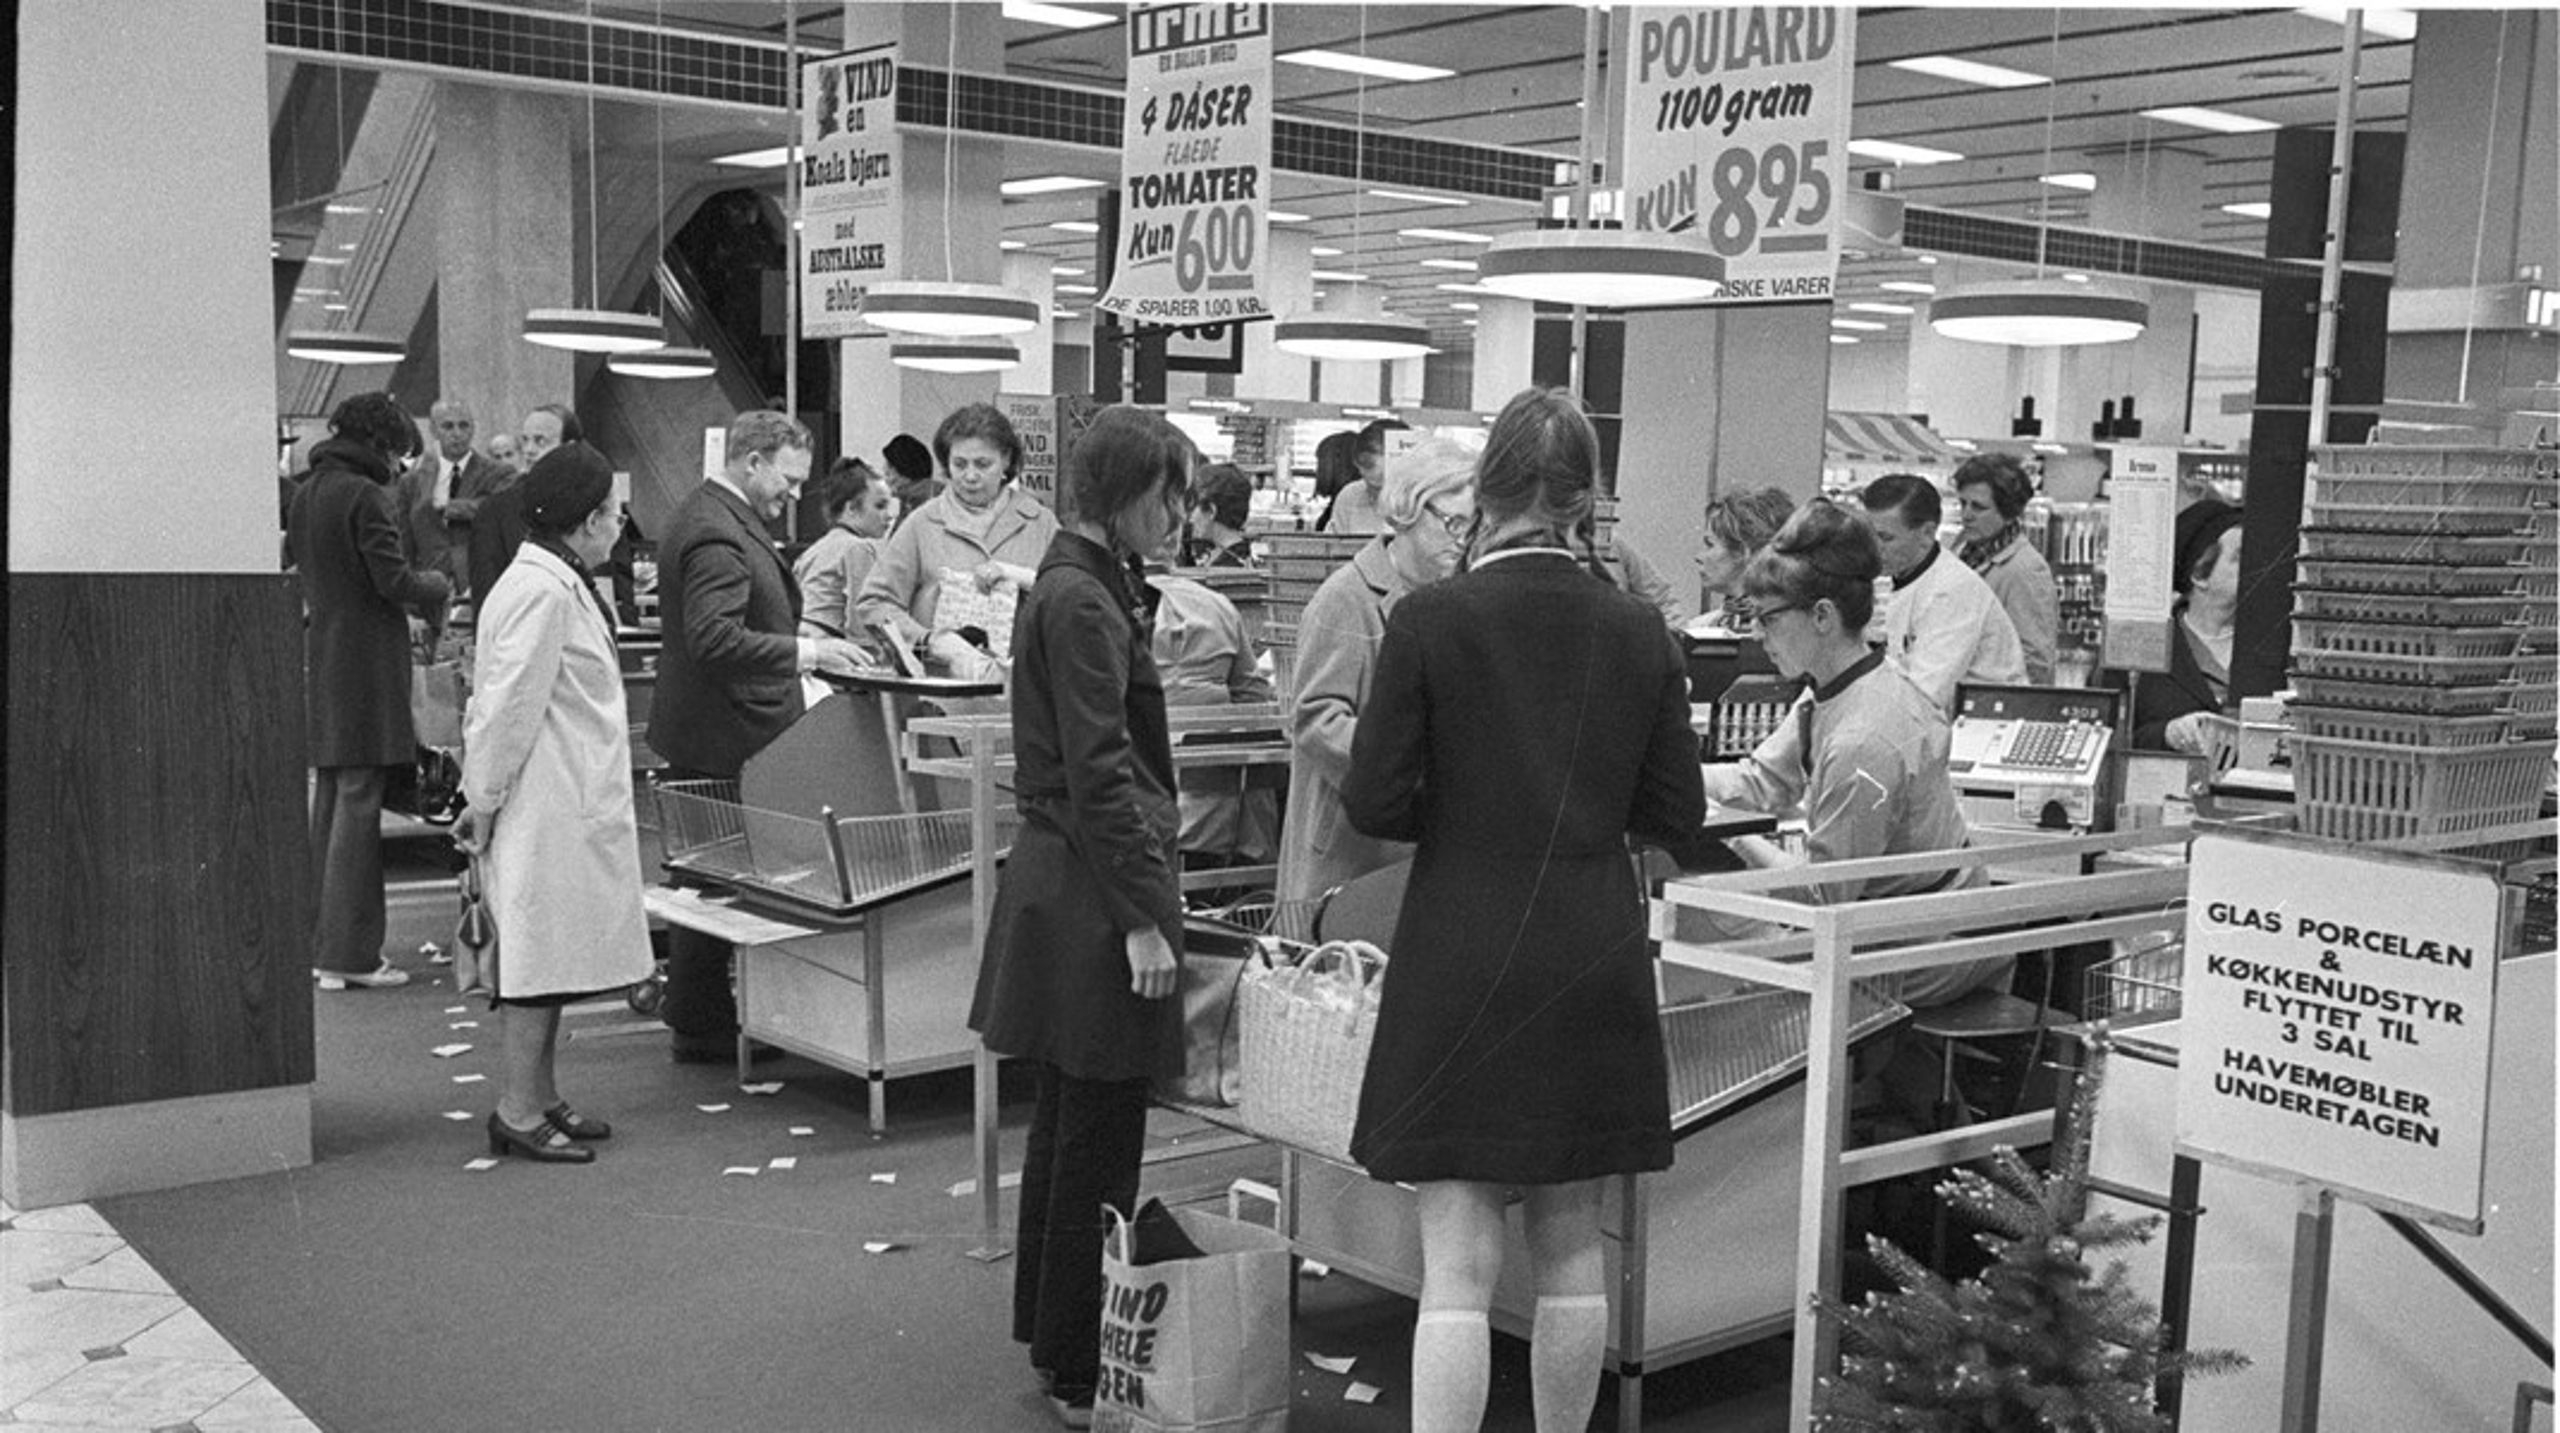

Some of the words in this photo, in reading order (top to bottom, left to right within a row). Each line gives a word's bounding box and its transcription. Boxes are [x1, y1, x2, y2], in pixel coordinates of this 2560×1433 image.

[1138, 3, 1260, 50] irma
[1640, 6, 1836, 83] POULARD
[845, 57, 893, 104] VIND
[847, 106, 865, 132] en
[1141, 95, 1157, 136] 4
[1164, 80, 1252, 132] DÅSER
[1656, 83, 1723, 132] 1100
[1722, 82, 1812, 137] gram
[805, 151, 845, 187] Koala
[850, 148, 891, 187] bjørn
[1129, 165, 1257, 209] TOMATER
[1635, 163, 1697, 231] KUN
[1708, 139, 1831, 257] 895
[808, 243, 885, 274] AUSTRALSKE
[1128, 220, 1174, 260] Kun
[1176, 204, 1254, 293] 600
[1104, 297, 1131, 312] DE
[1136, 299, 1199, 316] SPARER
[1771, 277, 1829, 295] VARER
[2208, 902, 2283, 934] GLAS
[2298, 917, 2473, 969] PORCELÆN
[2319, 949, 2342, 972] &
[2207, 953, 2465, 1026] KØKKENUDSTYR
[2243, 988, 2361, 1031] FLYTTET
[2378, 1016, 2419, 1045] TIL
[2281, 1022, 2299, 1044] 3
[2314, 1030, 2372, 1061] SAL
[2223, 1047, 2432, 1118] HAVEMØBLER
[2214, 1072, 2440, 1148] UNDERETAGEN
[1102, 1321, 1157, 1366] HELE
